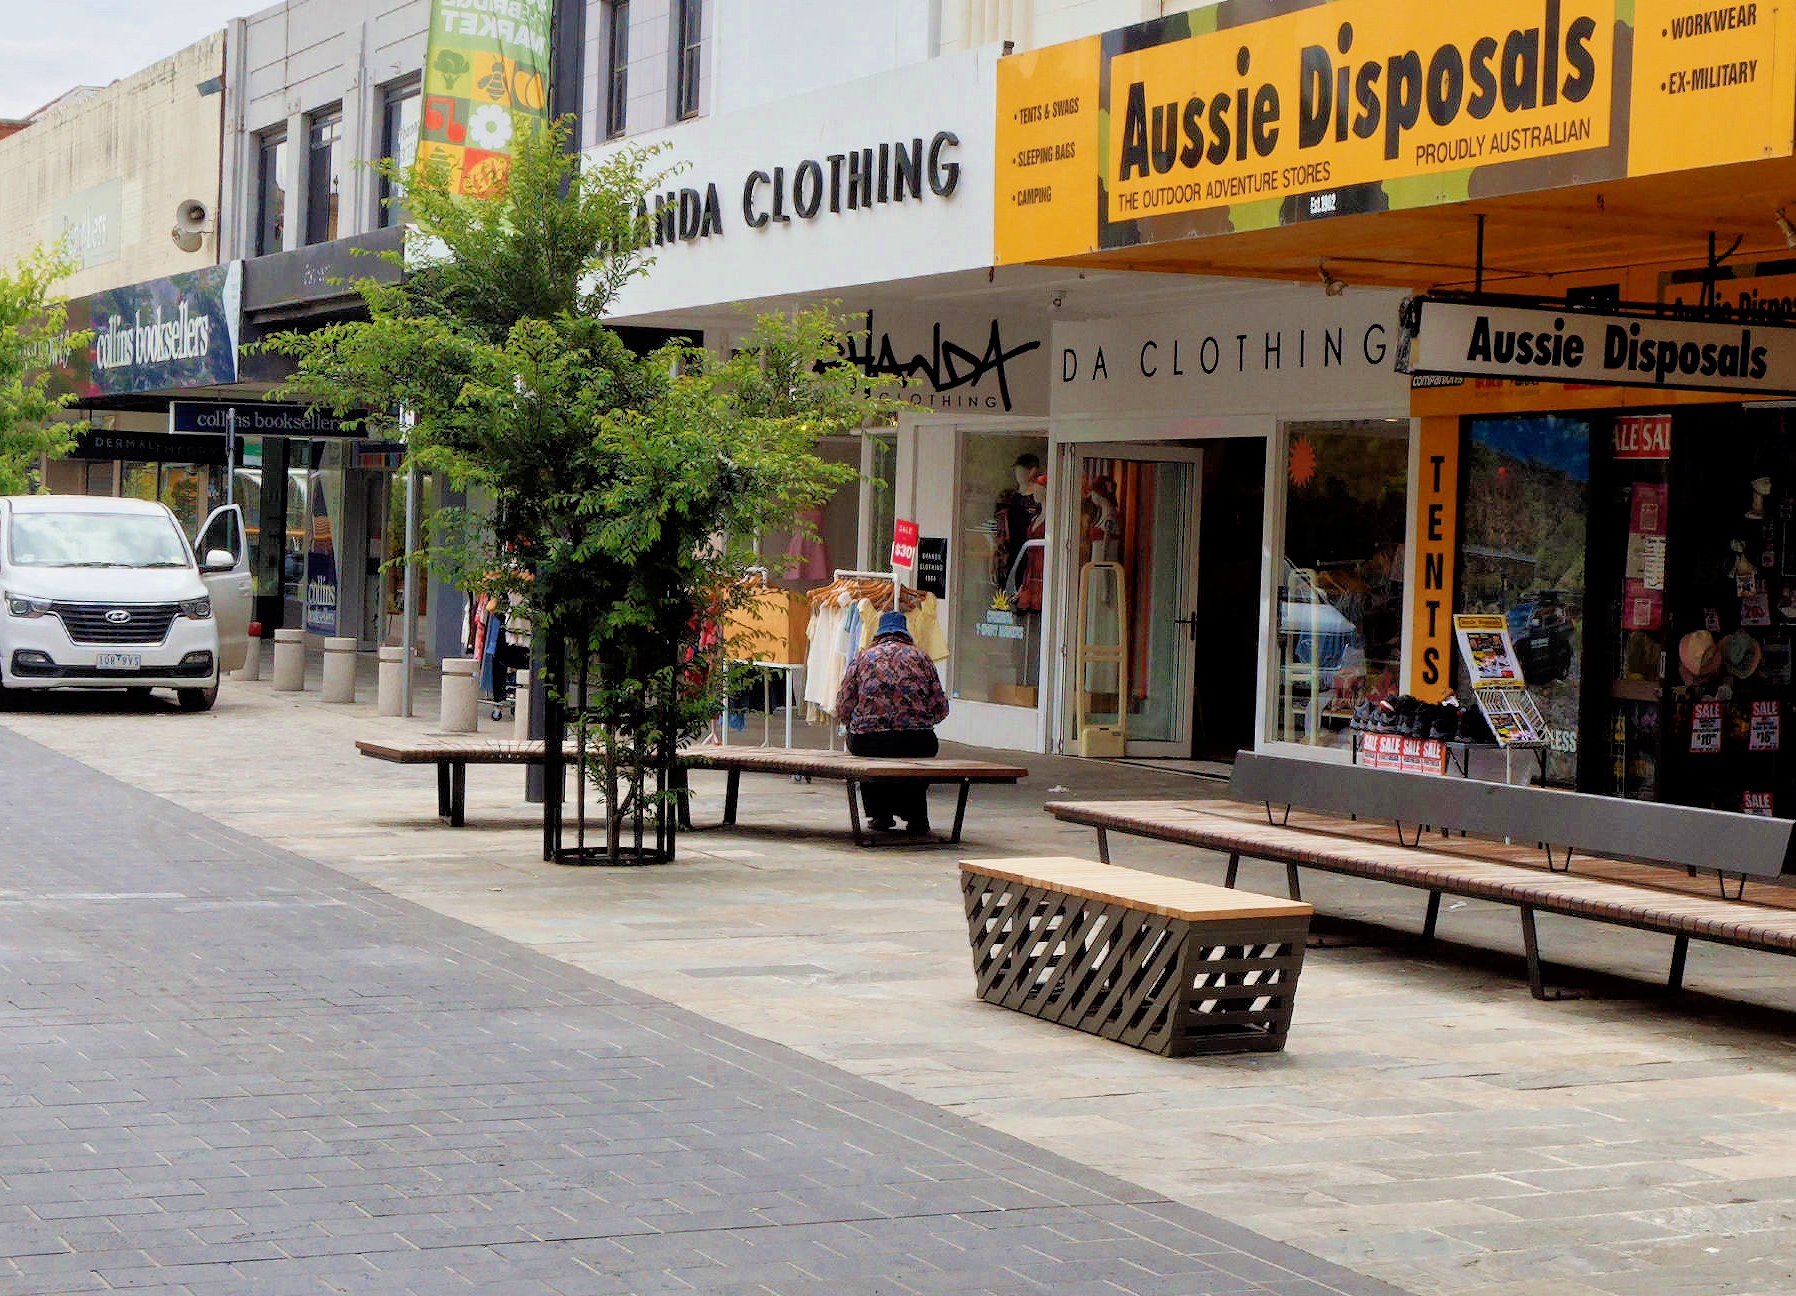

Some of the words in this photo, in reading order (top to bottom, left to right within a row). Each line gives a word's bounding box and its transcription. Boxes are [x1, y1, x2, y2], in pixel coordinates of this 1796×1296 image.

[1672, 3, 1757, 40] WORKWEAR
[1668, 59, 1758, 95] EX-MILITARY
[1020, 105, 1042, 125] TENTS
[1044, 104, 1050, 120] &
[1053, 97, 1080, 118] SWAGS
[1119, 46, 1280, 182] Aussie
[1018, 145, 1053, 168] SLEEPING
[1055, 141, 1076, 161] BAGS
[1416, 134, 1486, 166] PROUDLY
[1489, 117, 1591, 153] AUSTRALIAN
[742, 131, 960, 229] CLOTHING
[1017, 185, 1052, 206] CAMPING
[1118, 191, 1139, 213] THE
[1143, 182, 1202, 208] OUTDOOR
[1206, 170, 1278, 199] ADVENTURE
[1282, 161, 1331, 188] STORES
[96, 312, 134, 370] collins
[135, 301, 210, 366] booksellers
[1063, 346, 1108, 383] DA
[1140, 324, 1387, 378] CLOTHING
[1467, 315, 1584, 369] Aussie
[1604, 323, 1768, 384] Disposals
[197, 412, 250, 429] collns
[895, 543, 912, 559] $30
[1422, 456, 1445, 685] TENTS
[1695, 704, 1720, 719] SALE
[1754, 701, 1780, 716] SALE
[1379, 736, 1401, 753] SALE
[1403, 738, 1421, 756] SALE
[1423, 740, 1442, 758] SALE
[1745, 794, 1771, 809] SALE
